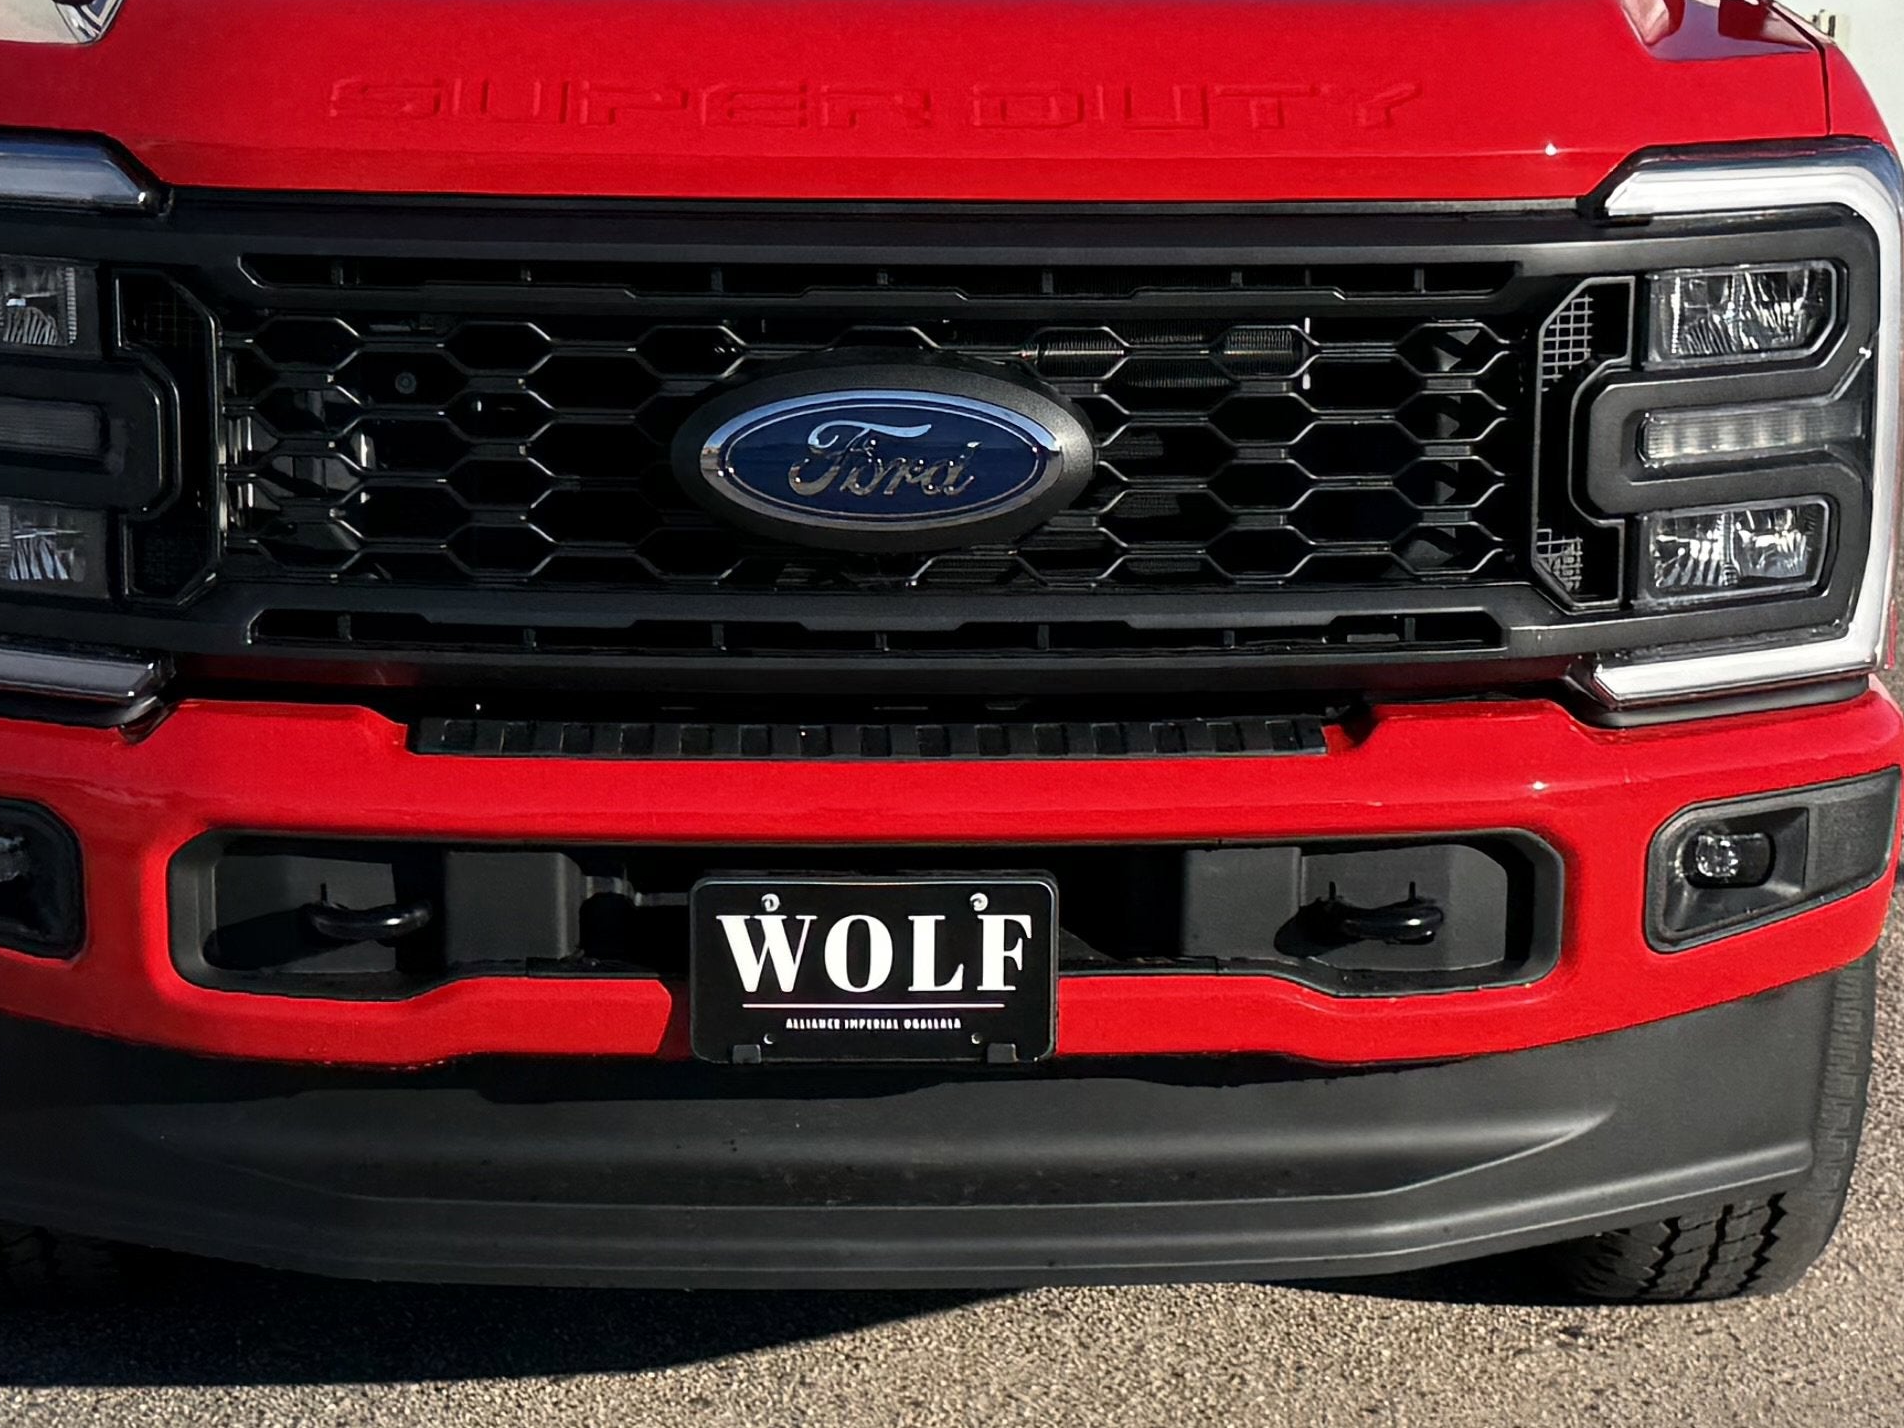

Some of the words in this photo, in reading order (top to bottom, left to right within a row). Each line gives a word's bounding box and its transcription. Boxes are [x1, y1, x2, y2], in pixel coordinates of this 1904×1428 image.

[328, 76, 932, 129] SUPER
[970, 80, 1424, 132] DUTY
[787, 419, 984, 497] Ford
[715, 914, 1033, 993] WOLF
